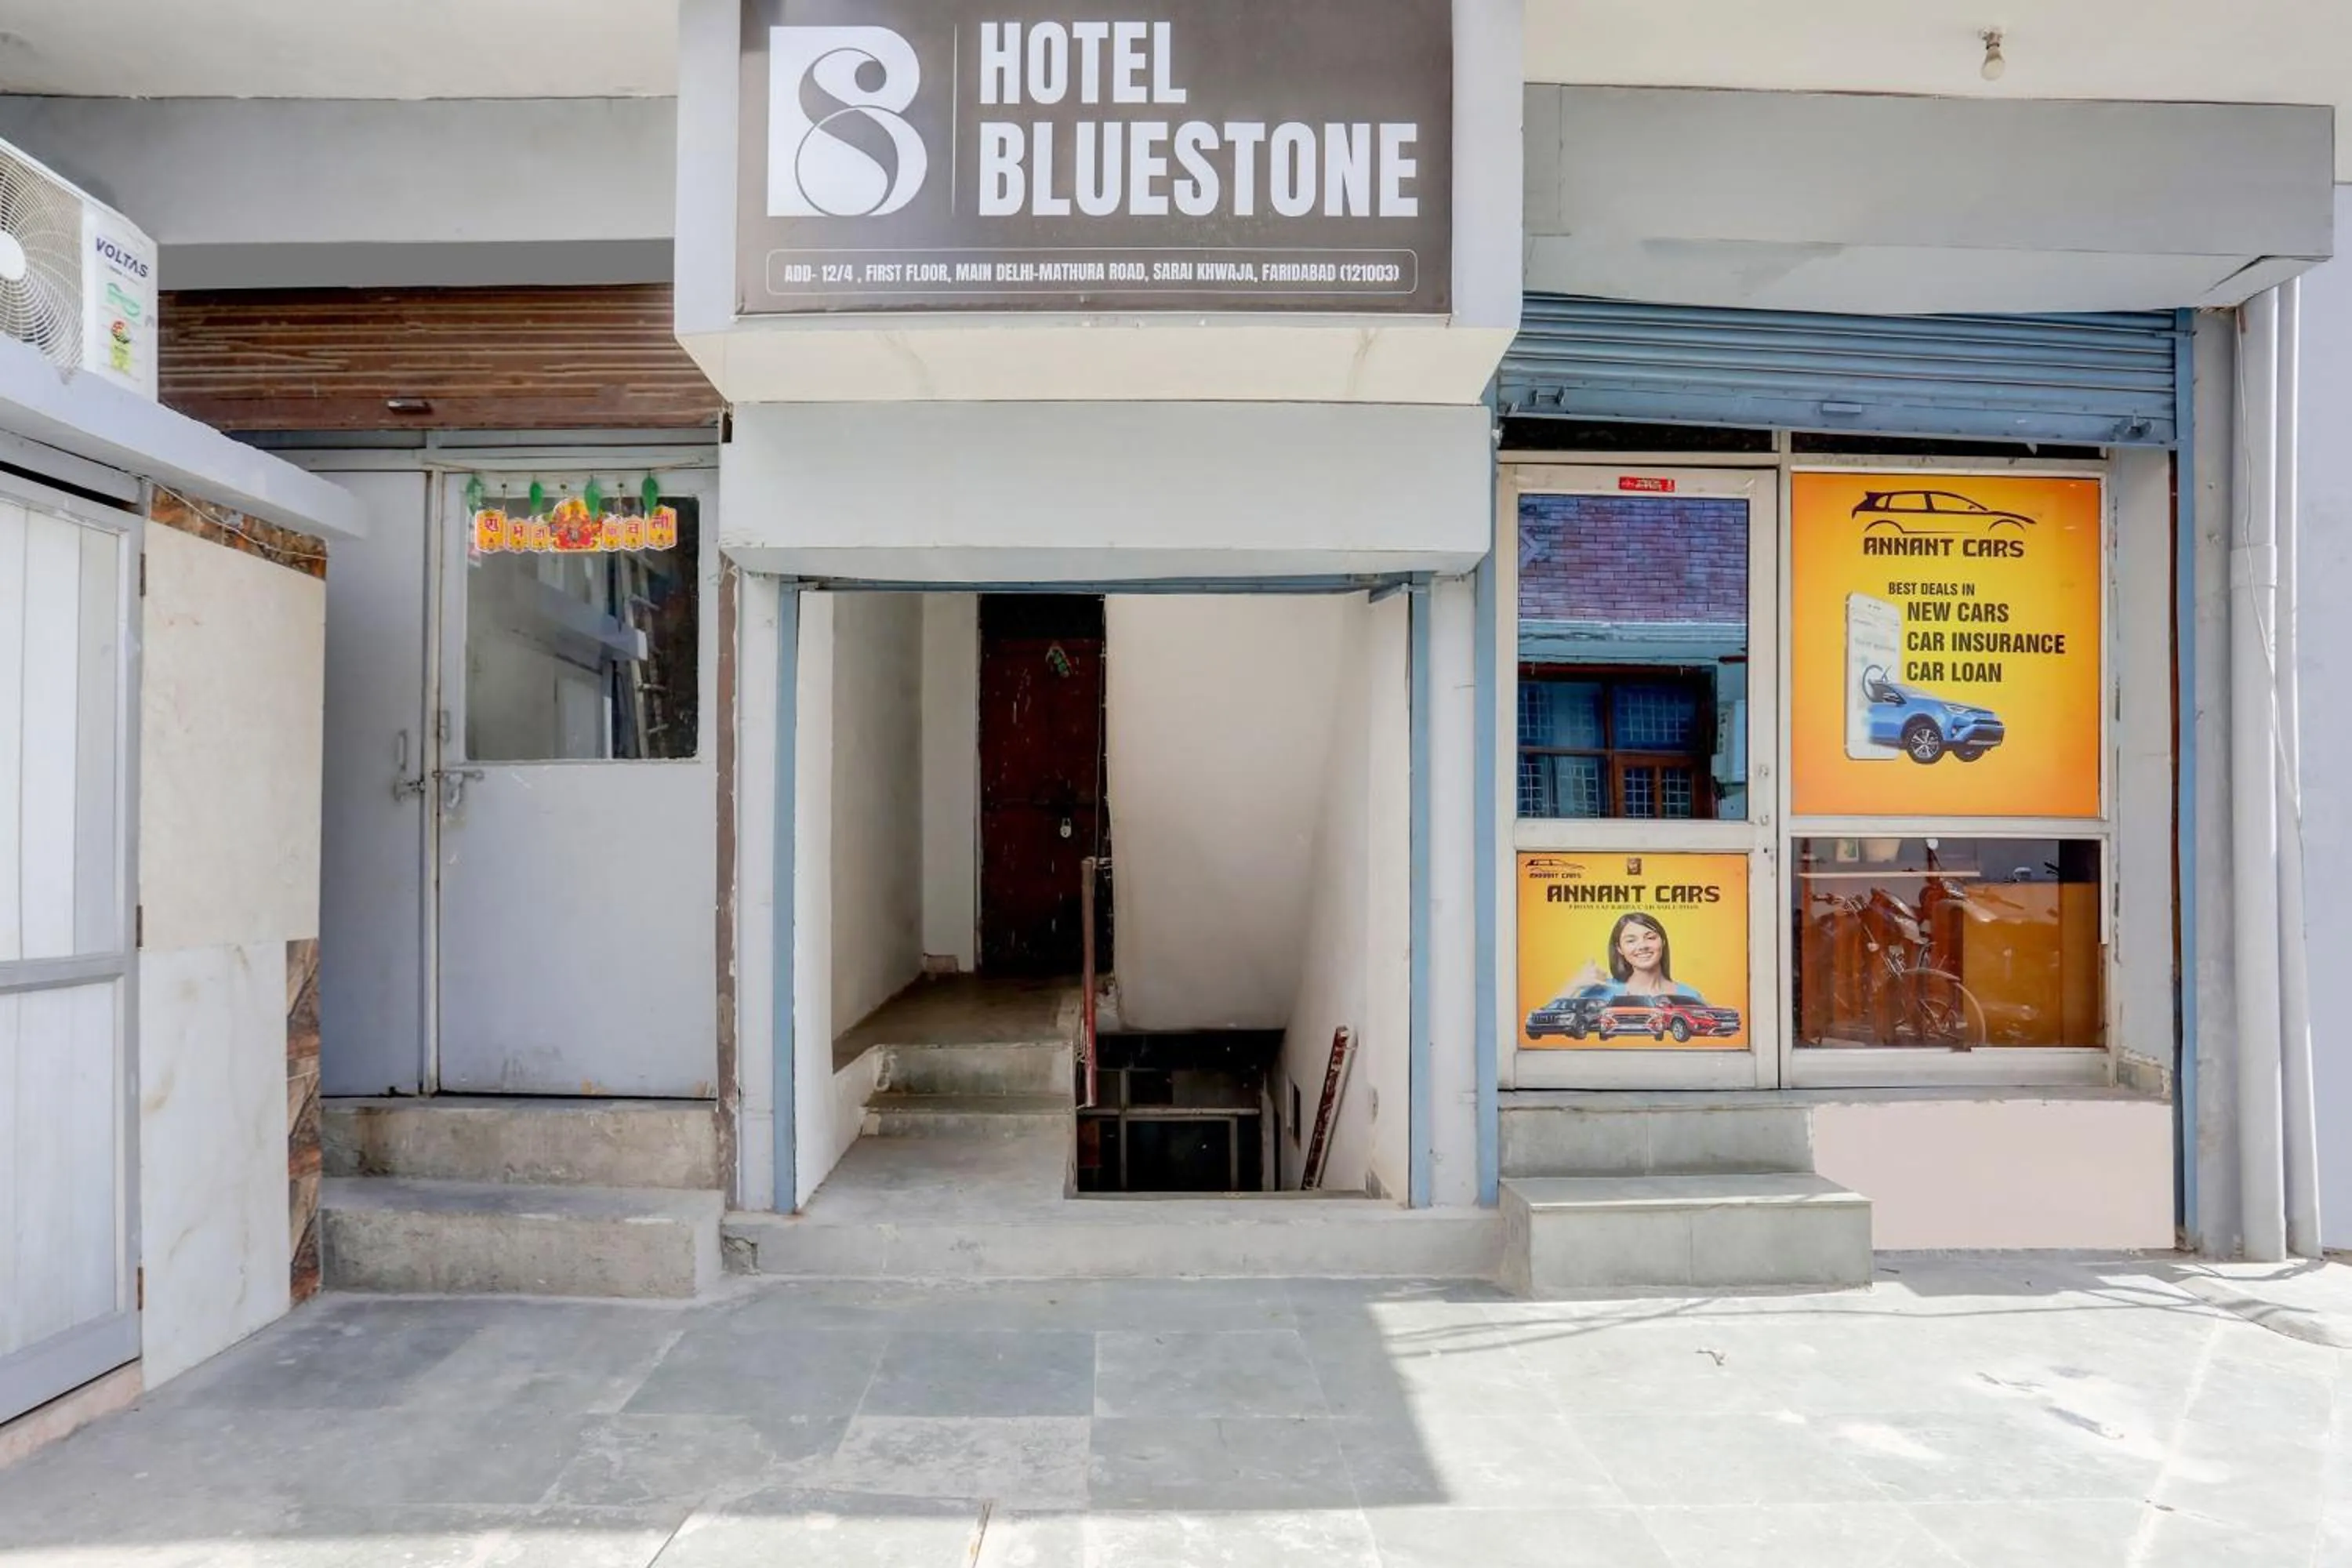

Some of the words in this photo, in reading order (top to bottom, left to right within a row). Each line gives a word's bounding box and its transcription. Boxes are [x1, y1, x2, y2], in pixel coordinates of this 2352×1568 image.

[979, 21, 1186, 104] HOTEL
[978, 122, 1418, 218] BLUESTONE
[95, 238, 149, 278] VOLTAS
[784, 264, 818, 283] ADD-
[822, 264, 853, 282] 12/4
[866, 263, 902, 282] FIRST
[906, 263, 951, 283] FLOOR,
[956, 263, 992, 282] MAIN
[996, 263, 1104, 282] DELHI-MATHURA
[1109, 263, 1149, 282] ROAD,
[1153, 263, 1192, 281] SARAI
[1197, 263, 1258, 283] KHWAJA,
[1262, 263, 1336, 282] FARIDABAD
[1340, 263, 1399, 282] (121003)
[1864, 537, 1954, 557] ANNANT
[1962, 539, 2024, 558] CARS
[1889, 582, 1916, 595] BEST
[1922, 583, 1958, 596] DEALS
[1962, 583, 1975, 596] IN
[1907, 601, 1951, 622] NEW
[1958, 603, 2009, 622] CARS
[1907, 632, 1944, 652] CAR
[1952, 632, 2065, 654] INSURANCE
[1907, 662, 1944, 681] CAR
[1951, 662, 2002, 683] LOAN
[1547, 884, 1646, 902] ANNANT
[1655, 884, 1720, 902] CARS
